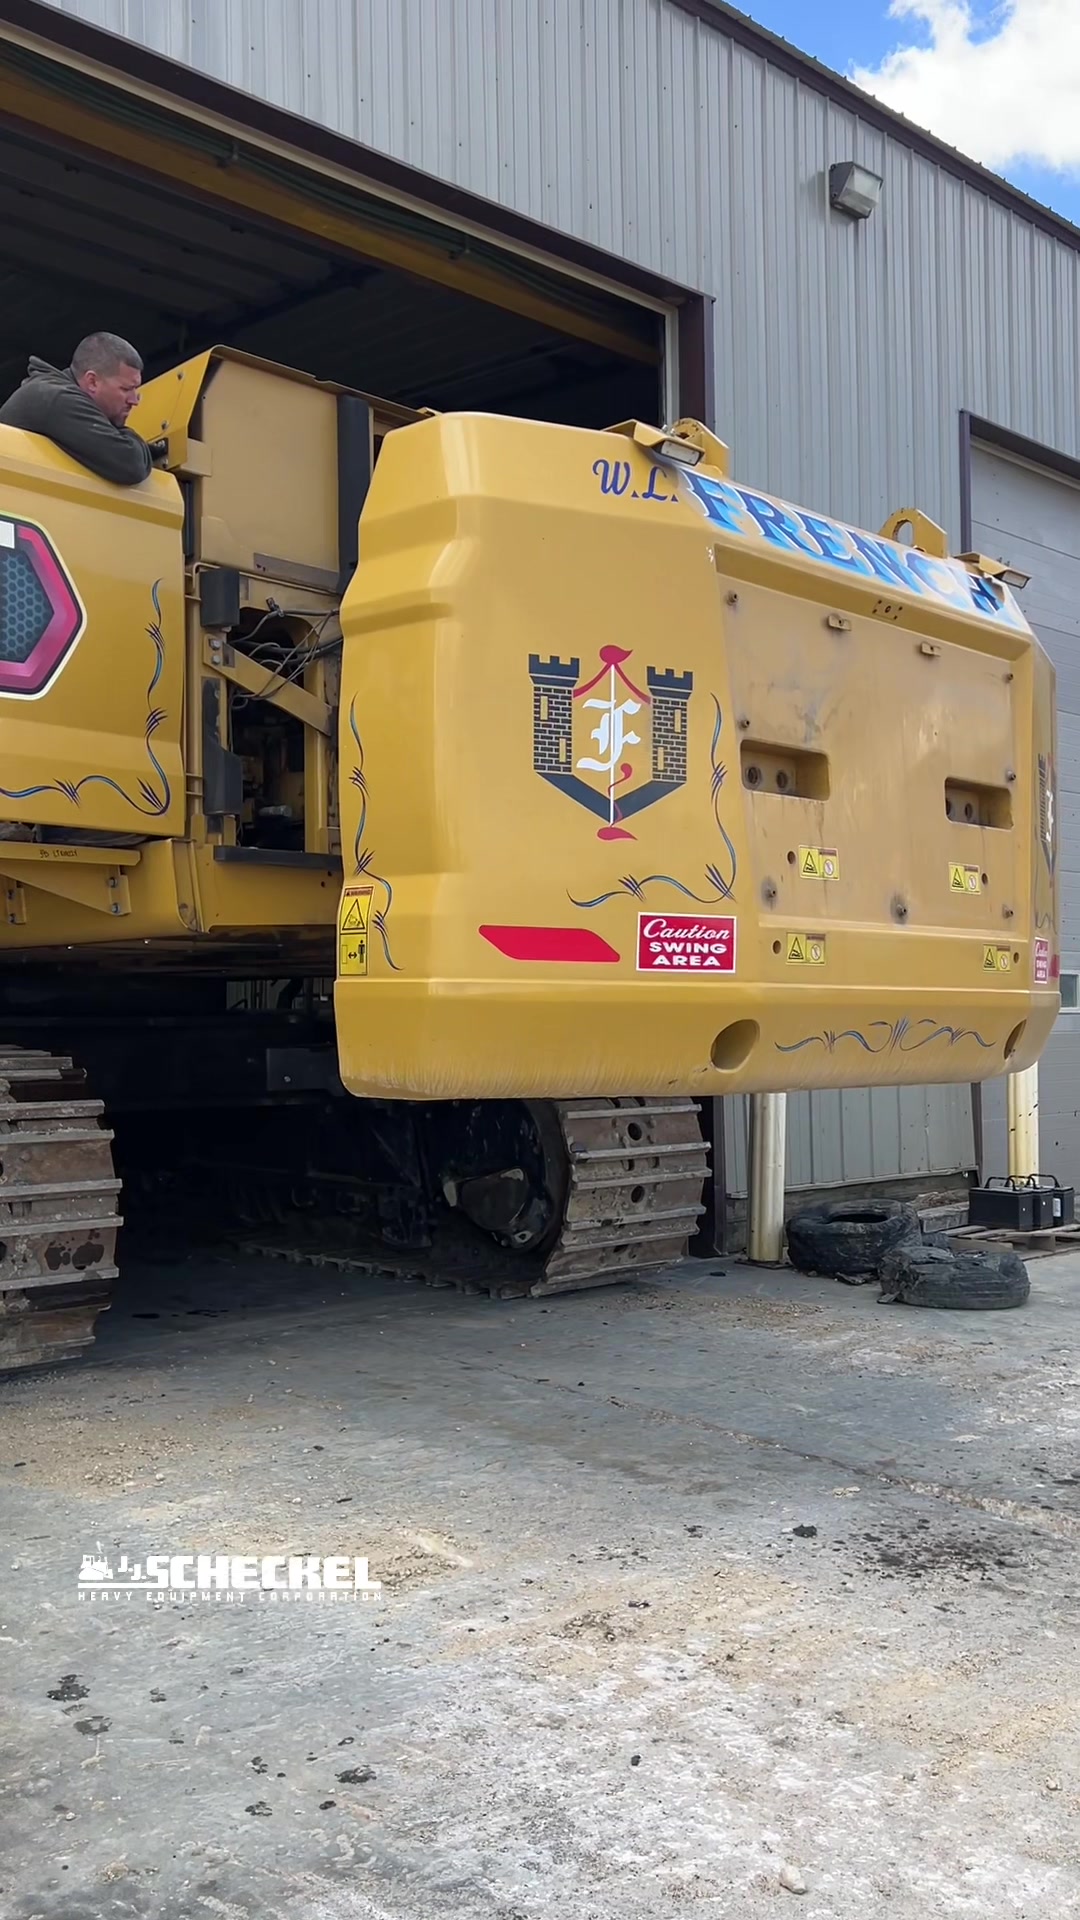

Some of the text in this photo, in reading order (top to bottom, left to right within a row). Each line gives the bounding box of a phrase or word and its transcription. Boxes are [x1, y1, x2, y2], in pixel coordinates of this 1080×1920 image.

[592, 459, 1012, 620] W.L. FRENCH
[643, 918, 730, 940] Caution
[649, 941, 727, 954] SWING
[652, 954, 721, 967] AREA
